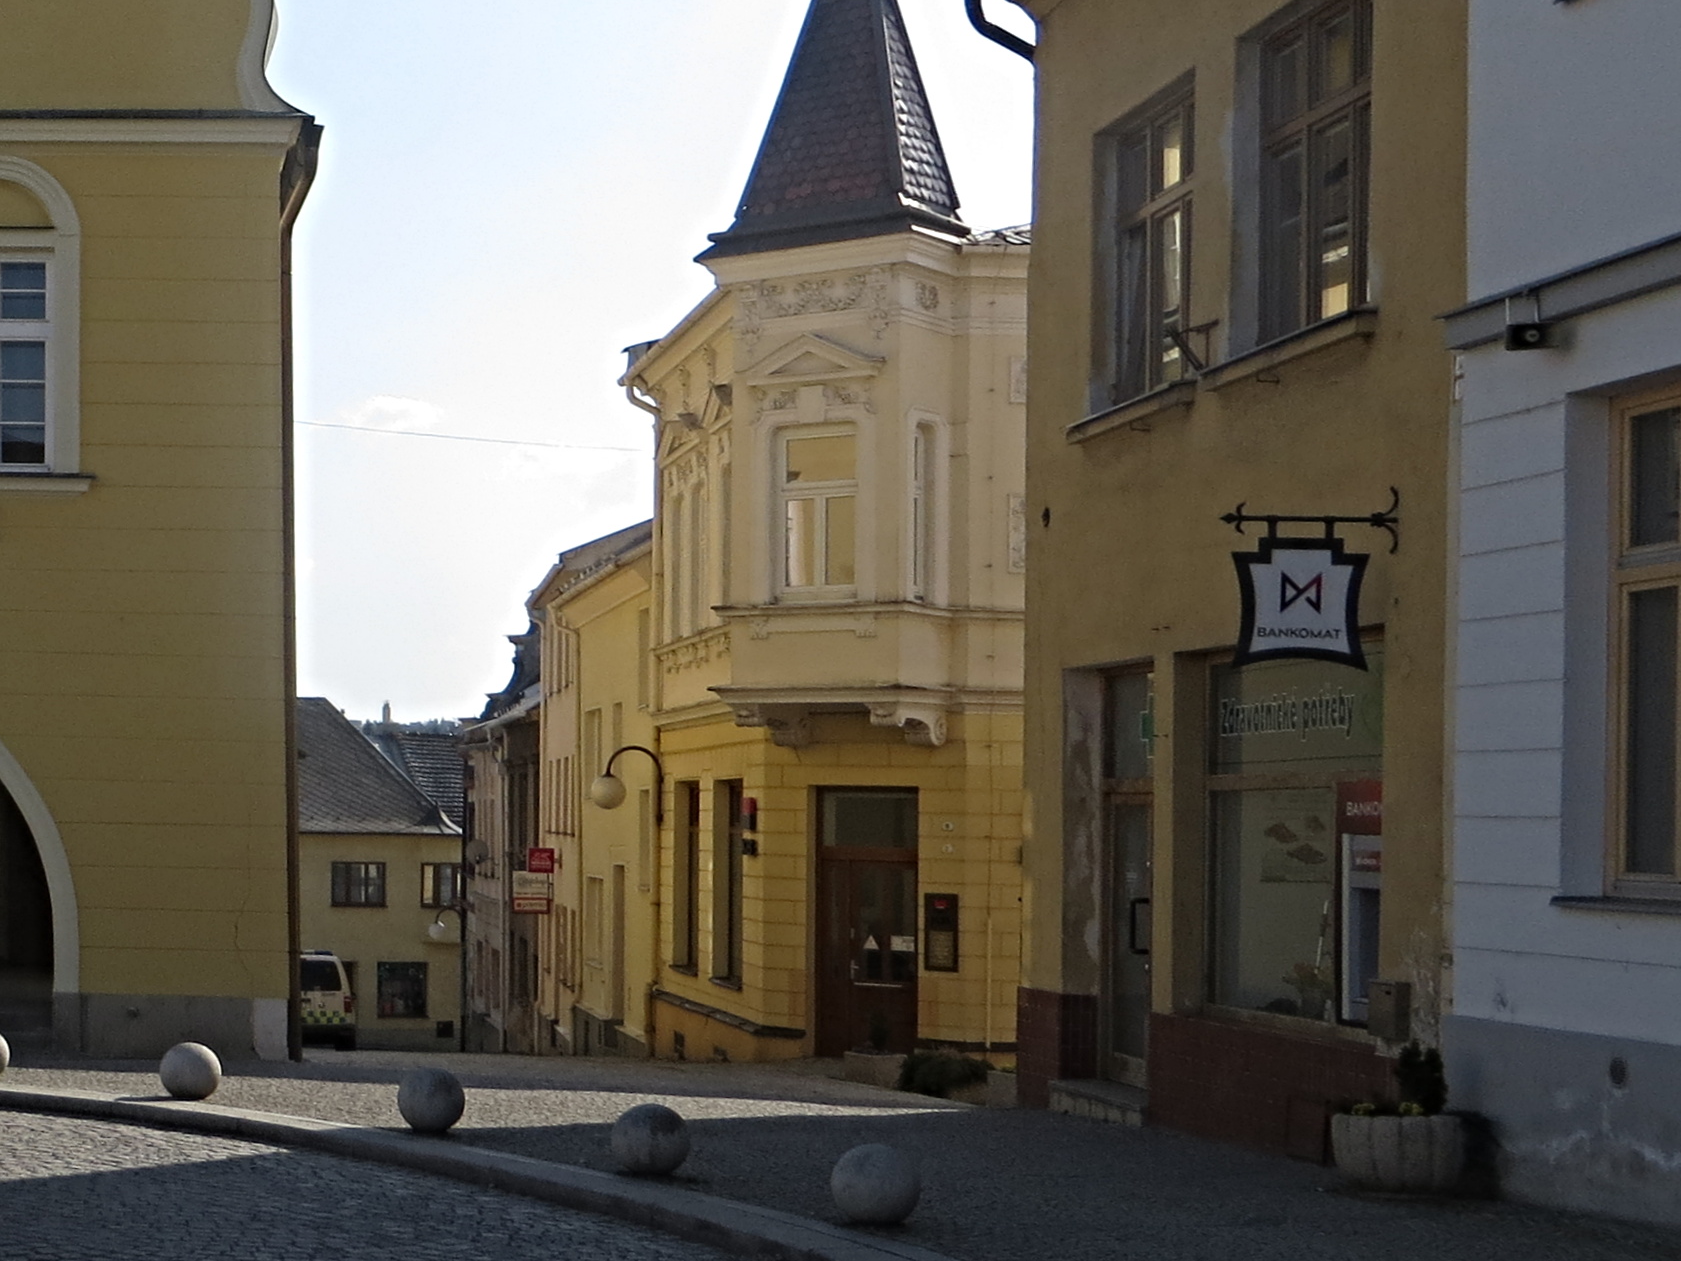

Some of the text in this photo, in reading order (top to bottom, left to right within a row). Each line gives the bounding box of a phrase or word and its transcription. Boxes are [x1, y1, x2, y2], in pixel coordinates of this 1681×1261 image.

[1257, 626, 1342, 639] BANKOMAT
[1220, 682, 1356, 743] Zdravotnické potřeby
[1346, 801, 1382, 816] BANKO
